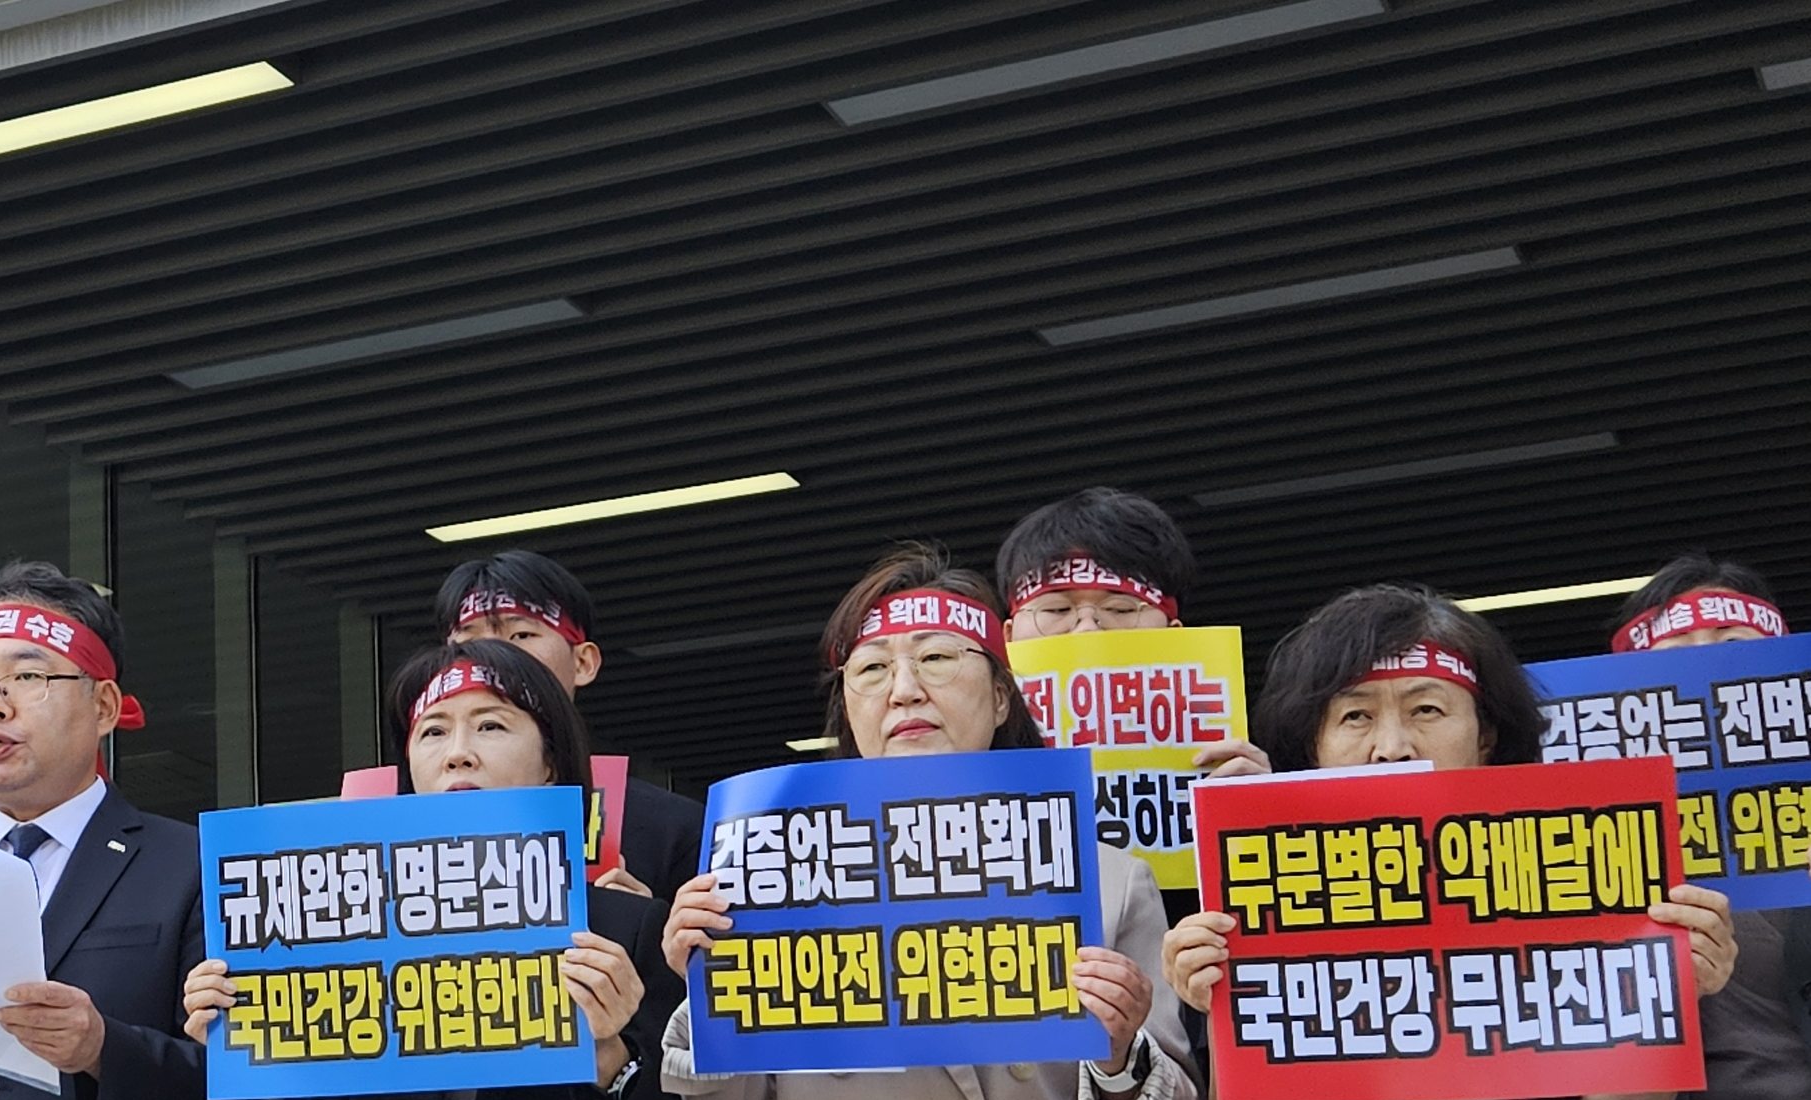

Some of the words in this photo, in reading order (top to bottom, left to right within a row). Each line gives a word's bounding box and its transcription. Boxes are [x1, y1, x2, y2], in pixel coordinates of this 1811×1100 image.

[23, 613, 75, 653] 수호
[887, 596, 940, 627] 확대
[946, 598, 988, 639] 저지
[1651, 601, 1695, 640] 배송
[1697, 597, 1748, 622] 확대
[1748, 602, 1783, 637] 저지
[1070, 668, 1226, 746] 외면하는
[1717, 676, 1811, 764] 전면
[223, 848, 384, 945] 규제완화
[395, 836, 566, 932] 명분삼아
[710, 808, 876, 907] 검증없는
[888, 797, 1075, 897] 전면확대
[1225, 823, 1425, 930] 무분별한
[1438, 809, 1664, 917] 약배달에!
[229, 966, 383, 1061] 국민건강
[396, 953, 573, 1051] 위협한다!
[710, 931, 884, 1028] 국민안전
[896, 921, 1081, 1021] 위협한다
[1236, 955, 1436, 1059] 국민건강
[1448, 941, 1677, 1052] 무너진다!
